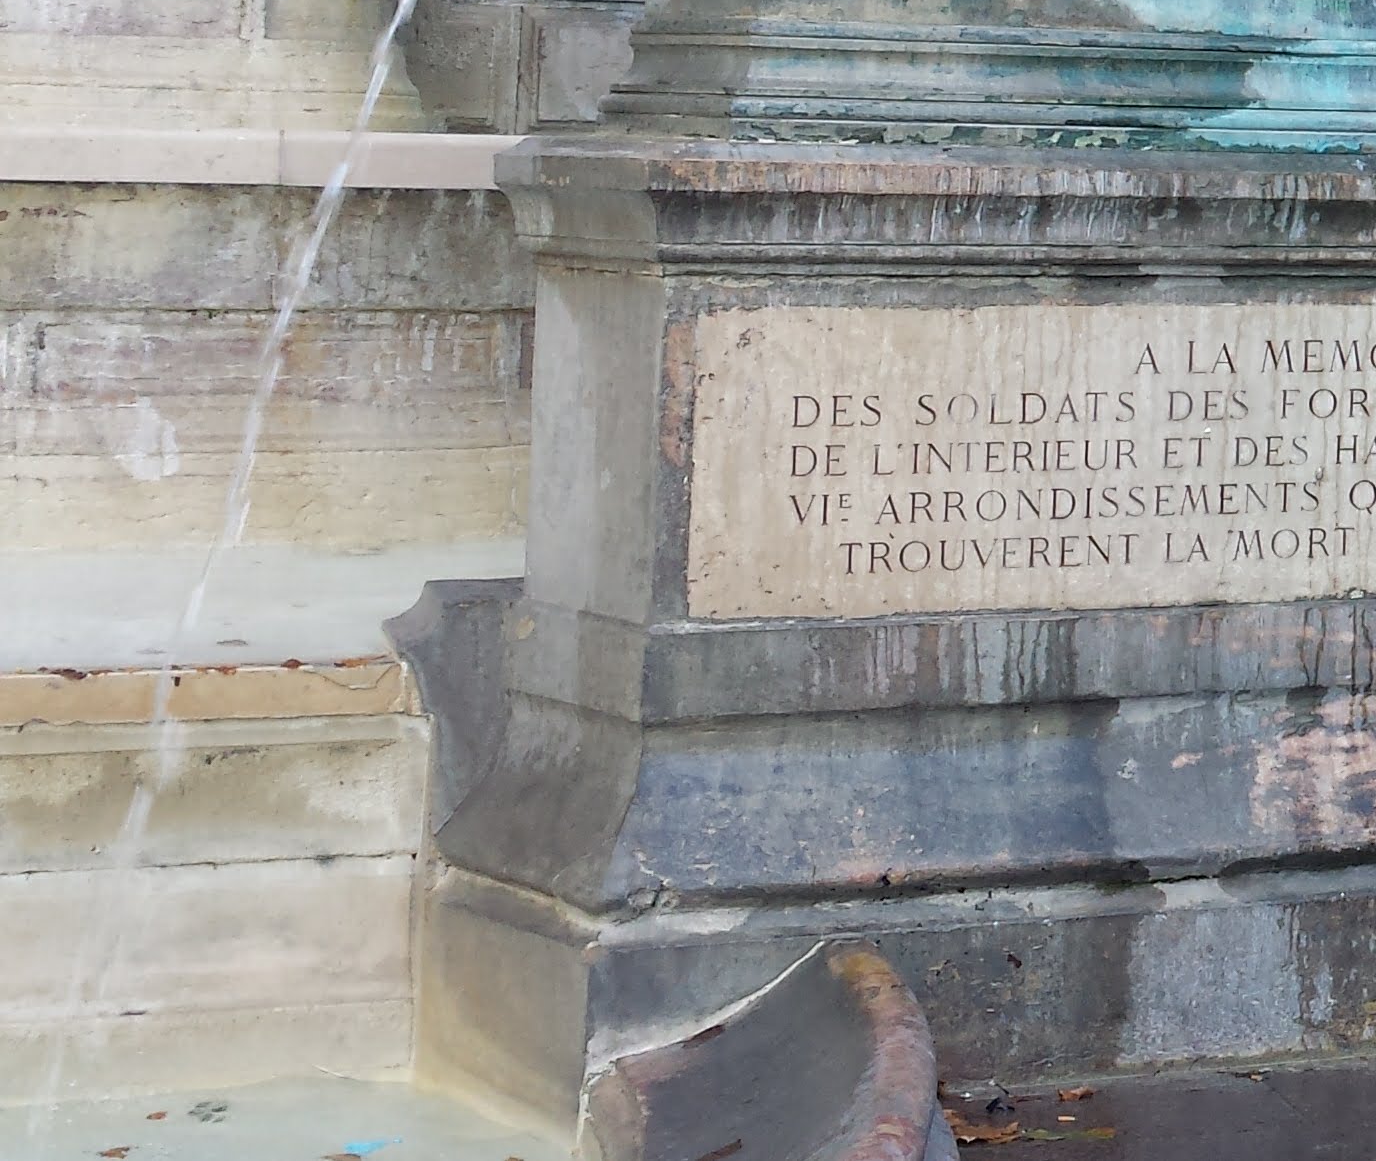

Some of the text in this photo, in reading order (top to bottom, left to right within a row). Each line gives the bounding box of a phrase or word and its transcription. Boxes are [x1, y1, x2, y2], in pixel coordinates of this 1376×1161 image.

[1135, 343, 1160, 375] A
[1187, 340, 1237, 374] LA
[792, 395, 882, 428] DES
[915, 391, 1136, 427] SOLDATS
[1167, 389, 1250, 423] DES
[790, 445, 848, 478] DE
[872, 440, 1138, 476] L'INTERIEUR
[1162, 437, 1212, 469] ET
[1234, 435, 1310, 468] DES
[875, 481, 1320, 525] ARRONDISSEMENTS
[839, 534, 1139, 575] TROUVERENT
[1164, 531, 1209, 562] LA
[1231, 526, 1353, 561] MORT
